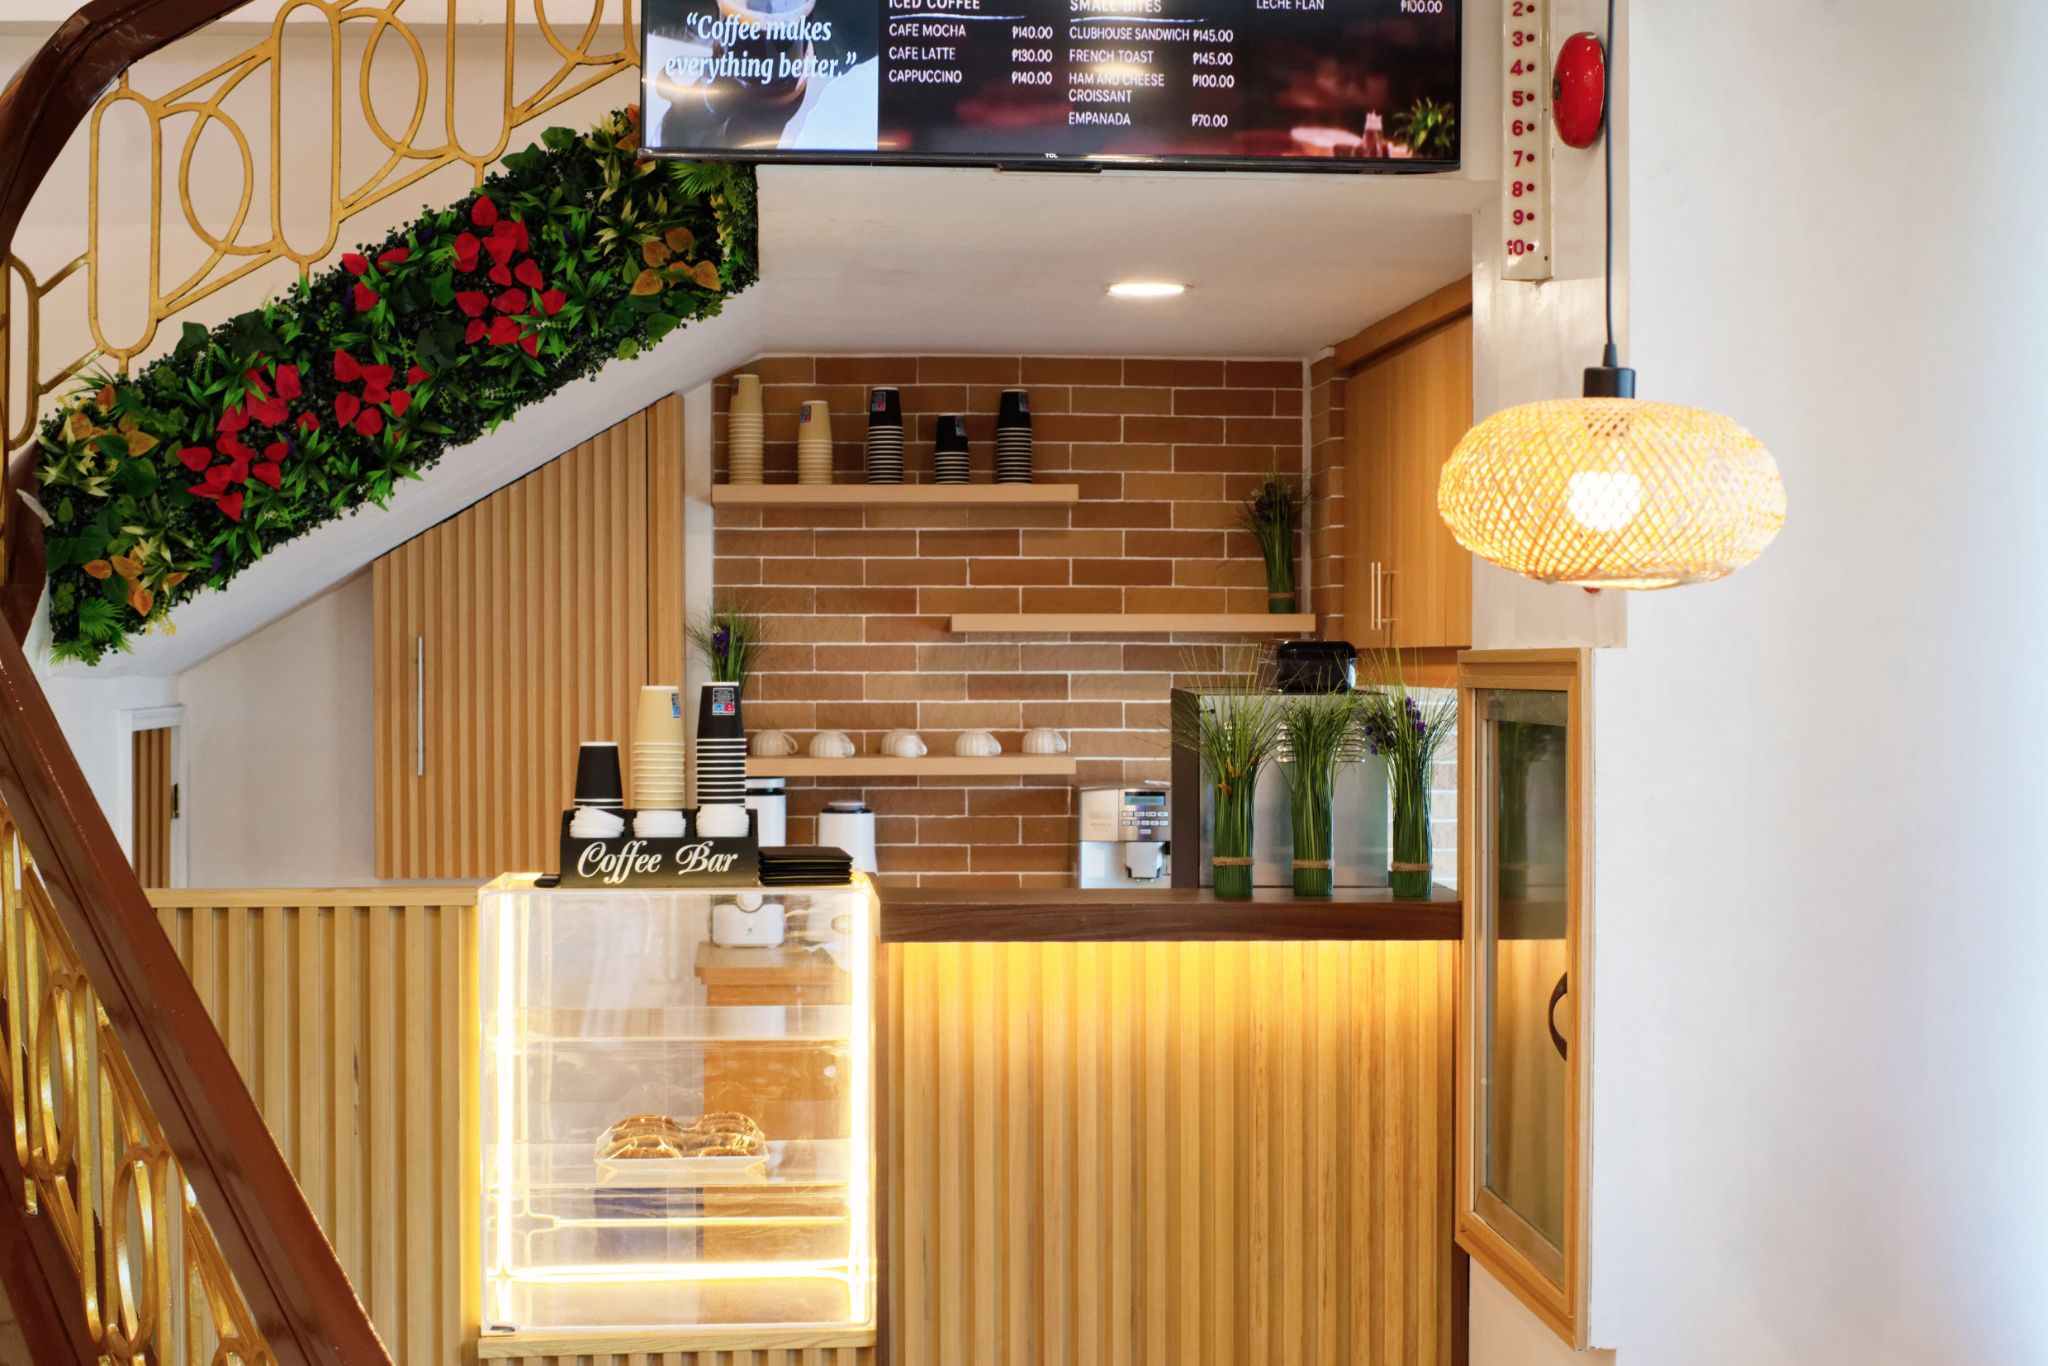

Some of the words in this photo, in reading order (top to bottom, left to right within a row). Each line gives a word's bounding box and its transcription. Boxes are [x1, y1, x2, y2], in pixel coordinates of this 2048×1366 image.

[889, 0, 921, 9] ICED
[927, 0, 980, 10] COFFEE
[1070, 0, 1118, 12] SMALL
[1123, 0, 1162, 13] BITES
[1256, 0, 1292, 10] LECHE
[1296, 0, 1324, 10] FLAN
[1512, 1, 1523, 17] 2
[766, 16, 832, 41] makes
[888, 23, 919, 37] CAFE
[922, 24, 966, 38] MOCHA
[1069, 26, 1132, 40] CLUBHOUSE
[1134, 27, 1189, 42] SANDWICH
[1512, 31, 1523, 47] 3
[888, 46, 919, 60] CAFE
[922, 47, 956, 60] LATTE
[1069, 49, 1114, 63] FRENCH
[1118, 50, 1154, 63] TOAST
[665, 50, 774, 85] everything
[1510, 60, 1523, 76] 4
[888, 69, 963, 84] CAPPUCCINO
[1068, 72, 1094, 86] HAM
[1096, 73, 1119, 86] AND
[1122, 73, 1165, 87] CHEESE
[1068, 89, 1132, 103] CROISSANT
[1512, 90, 1523, 107] 5
[1068, 112, 1131, 126] EMPANADA
[1511, 120, 1523, 136] 6
[1512, 151, 1523, 167] 7
[1511, 181, 1523, 197] 8
[1512, 209, 1523, 225] 9
[1506, 239, 1525, 256] 10
[577, 840, 661, 884] Coffee
[675, 840, 739, 876] Bar
